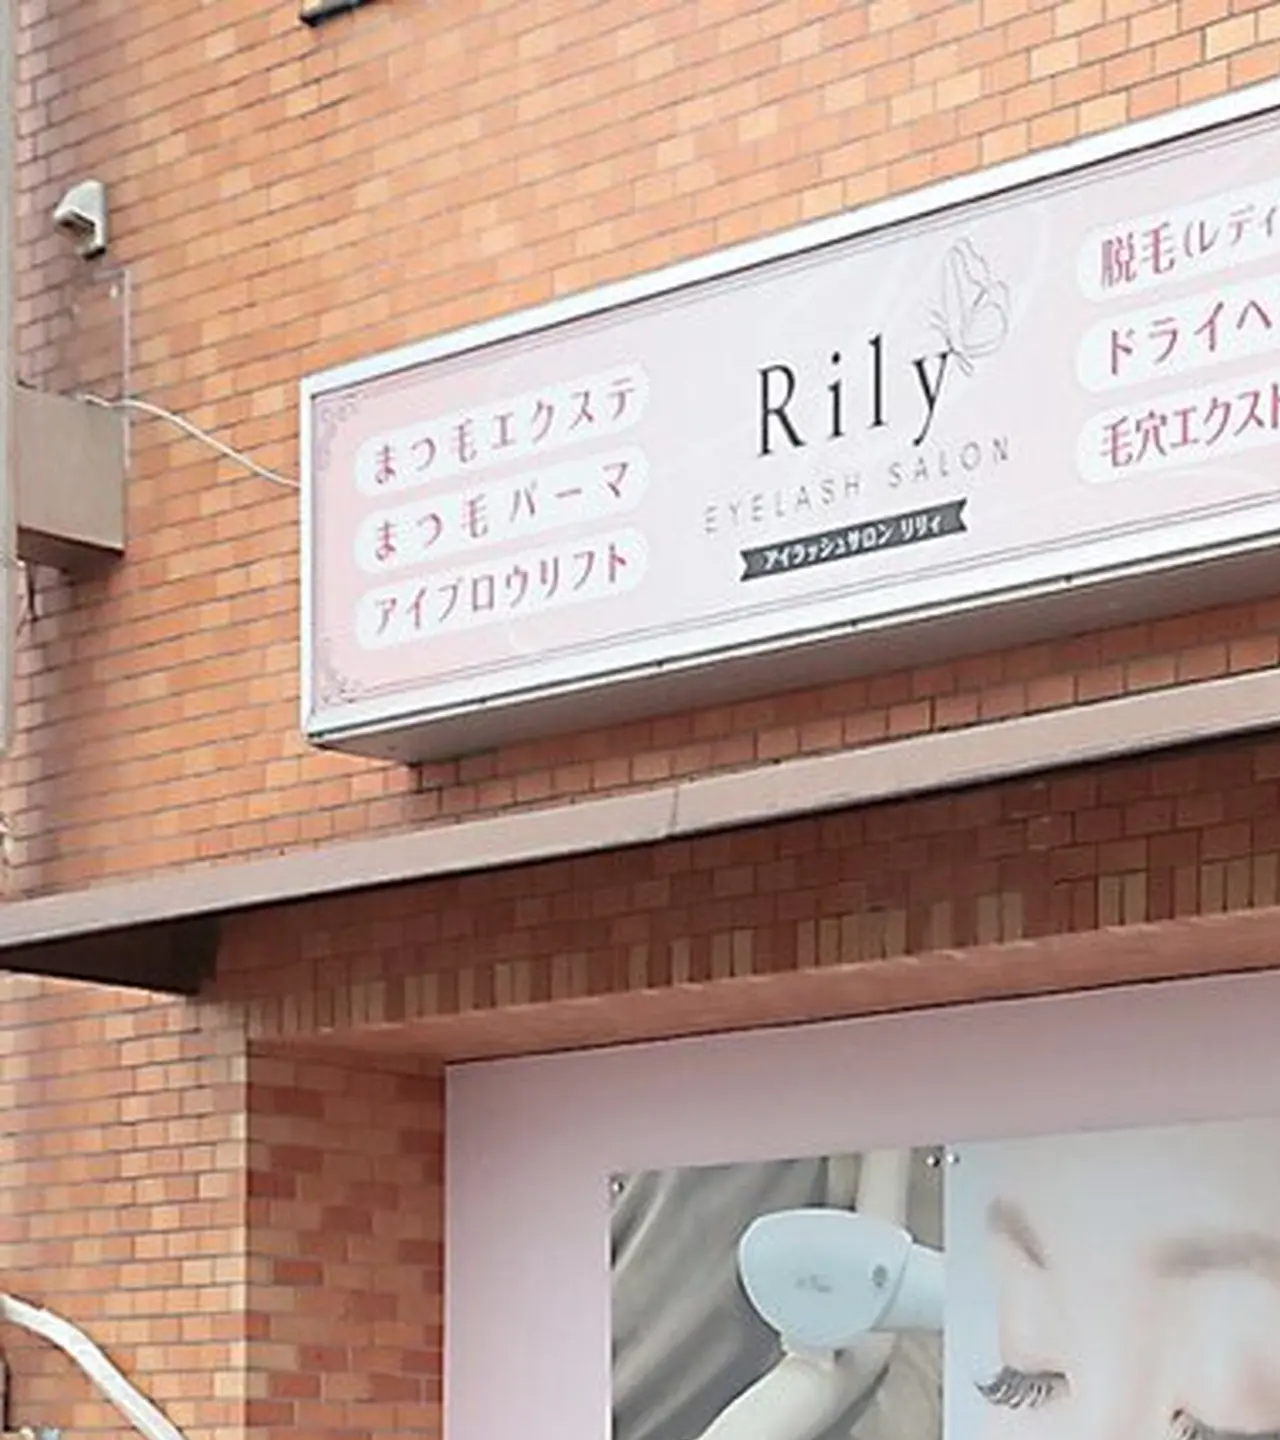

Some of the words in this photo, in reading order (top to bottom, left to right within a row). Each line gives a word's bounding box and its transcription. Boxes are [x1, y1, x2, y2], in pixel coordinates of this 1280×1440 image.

[374, 376, 637, 485] まつ毛エクステ
[757, 336, 955, 456] Rily
[374, 461, 630, 563] まつ毛パーマ
[704, 474, 862, 533] EYELASH
[888, 437, 1010, 489] SALON
[374, 541, 628, 633] アイブロウリフト
[762, 522, 893, 570] アイラッシュサロン
[900, 511, 943, 544] リリィ
